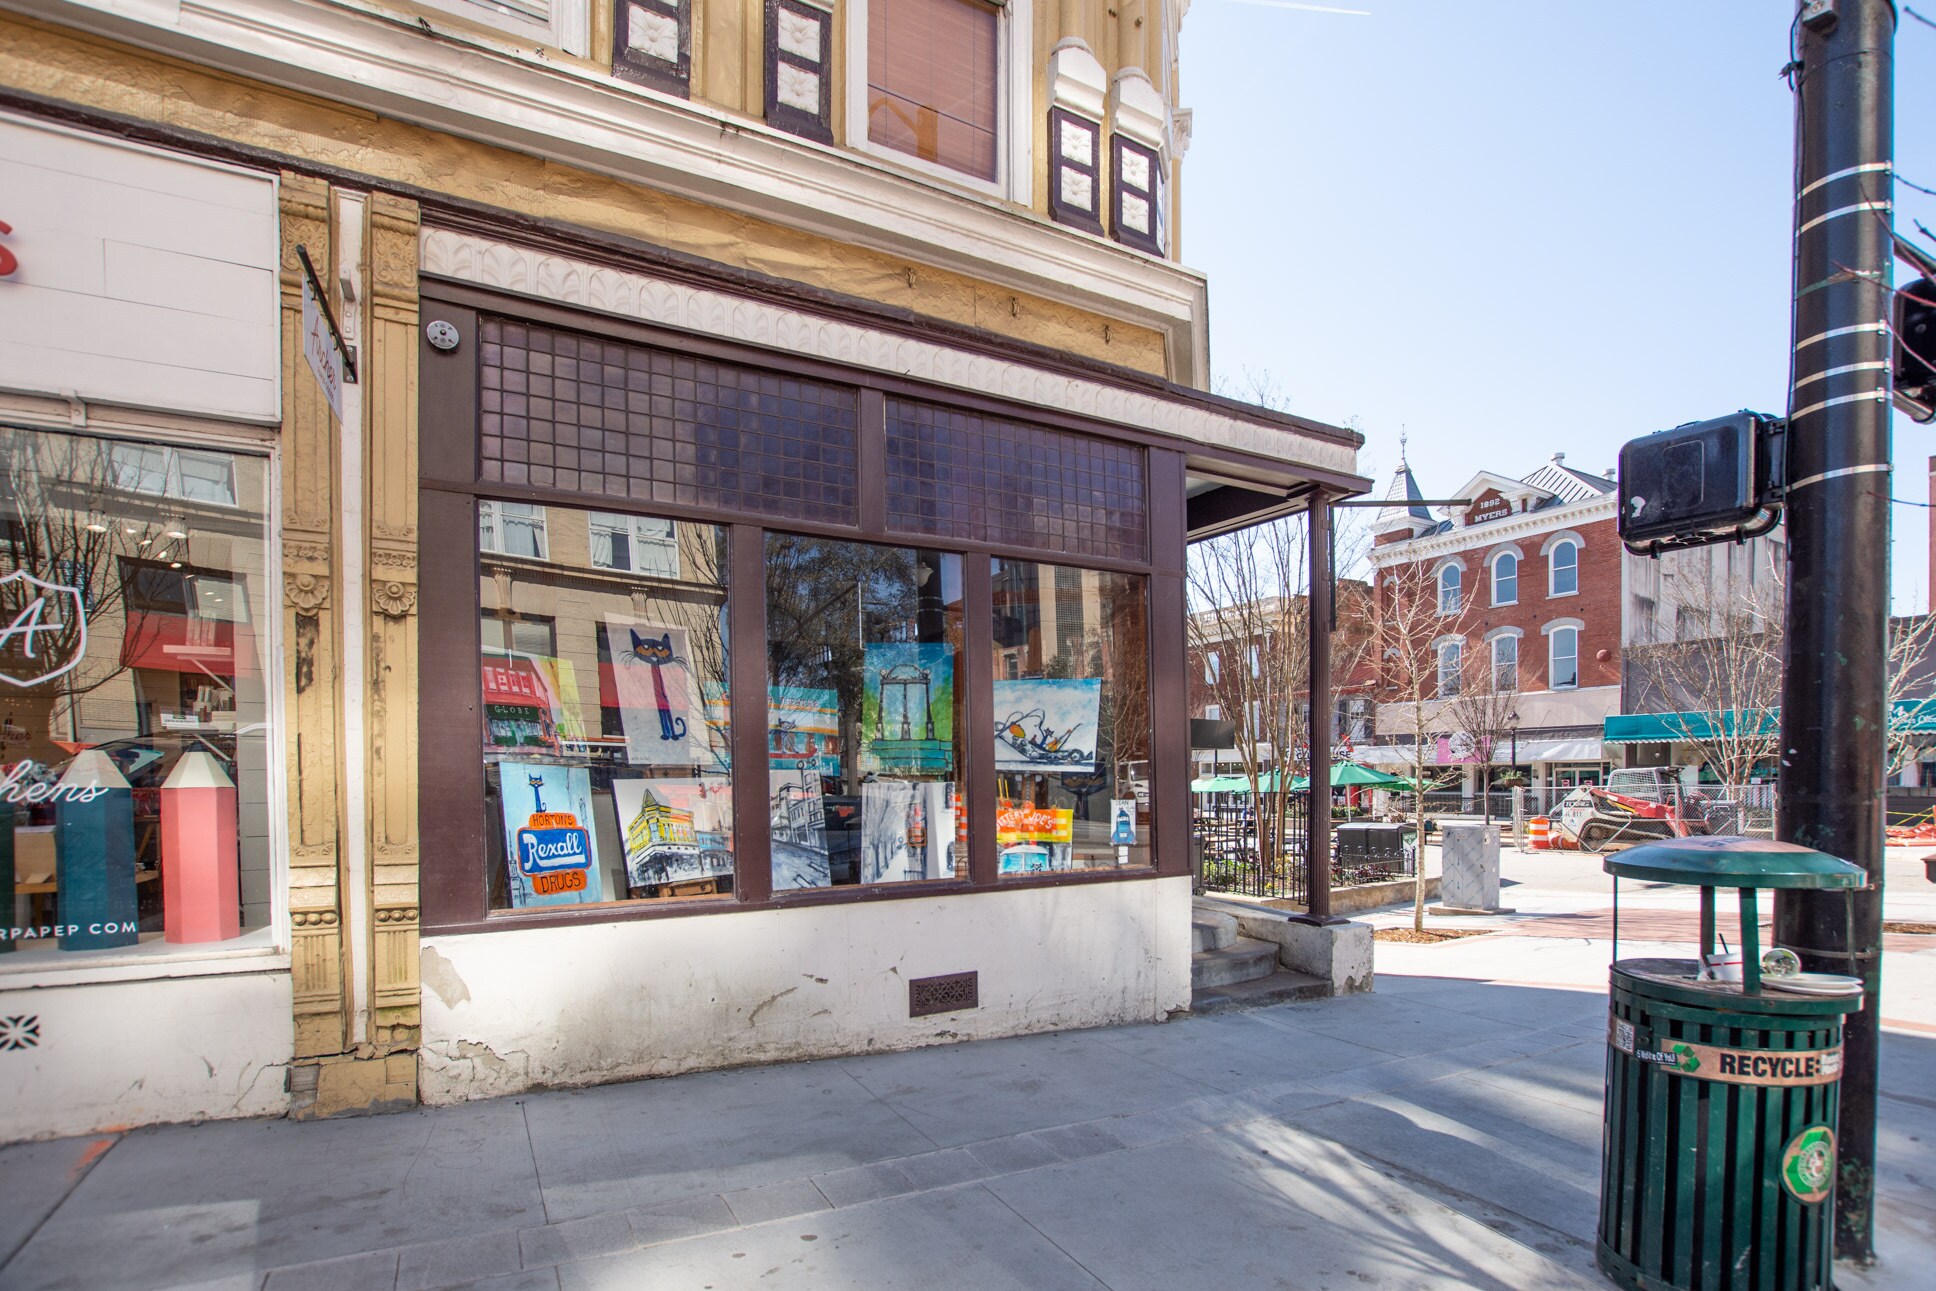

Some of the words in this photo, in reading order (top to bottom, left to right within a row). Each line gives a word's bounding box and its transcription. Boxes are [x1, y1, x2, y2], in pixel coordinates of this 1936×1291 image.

[1474, 508, 1508, 523] MYERS
[494, 705, 530, 715] GLOBE
[533, 814, 574, 827] HORTON'S
[522, 832, 586, 871] Rexall
[540, 871, 582, 894] DRUGS
[1719, 1052, 1820, 1079] RECYCLE:
